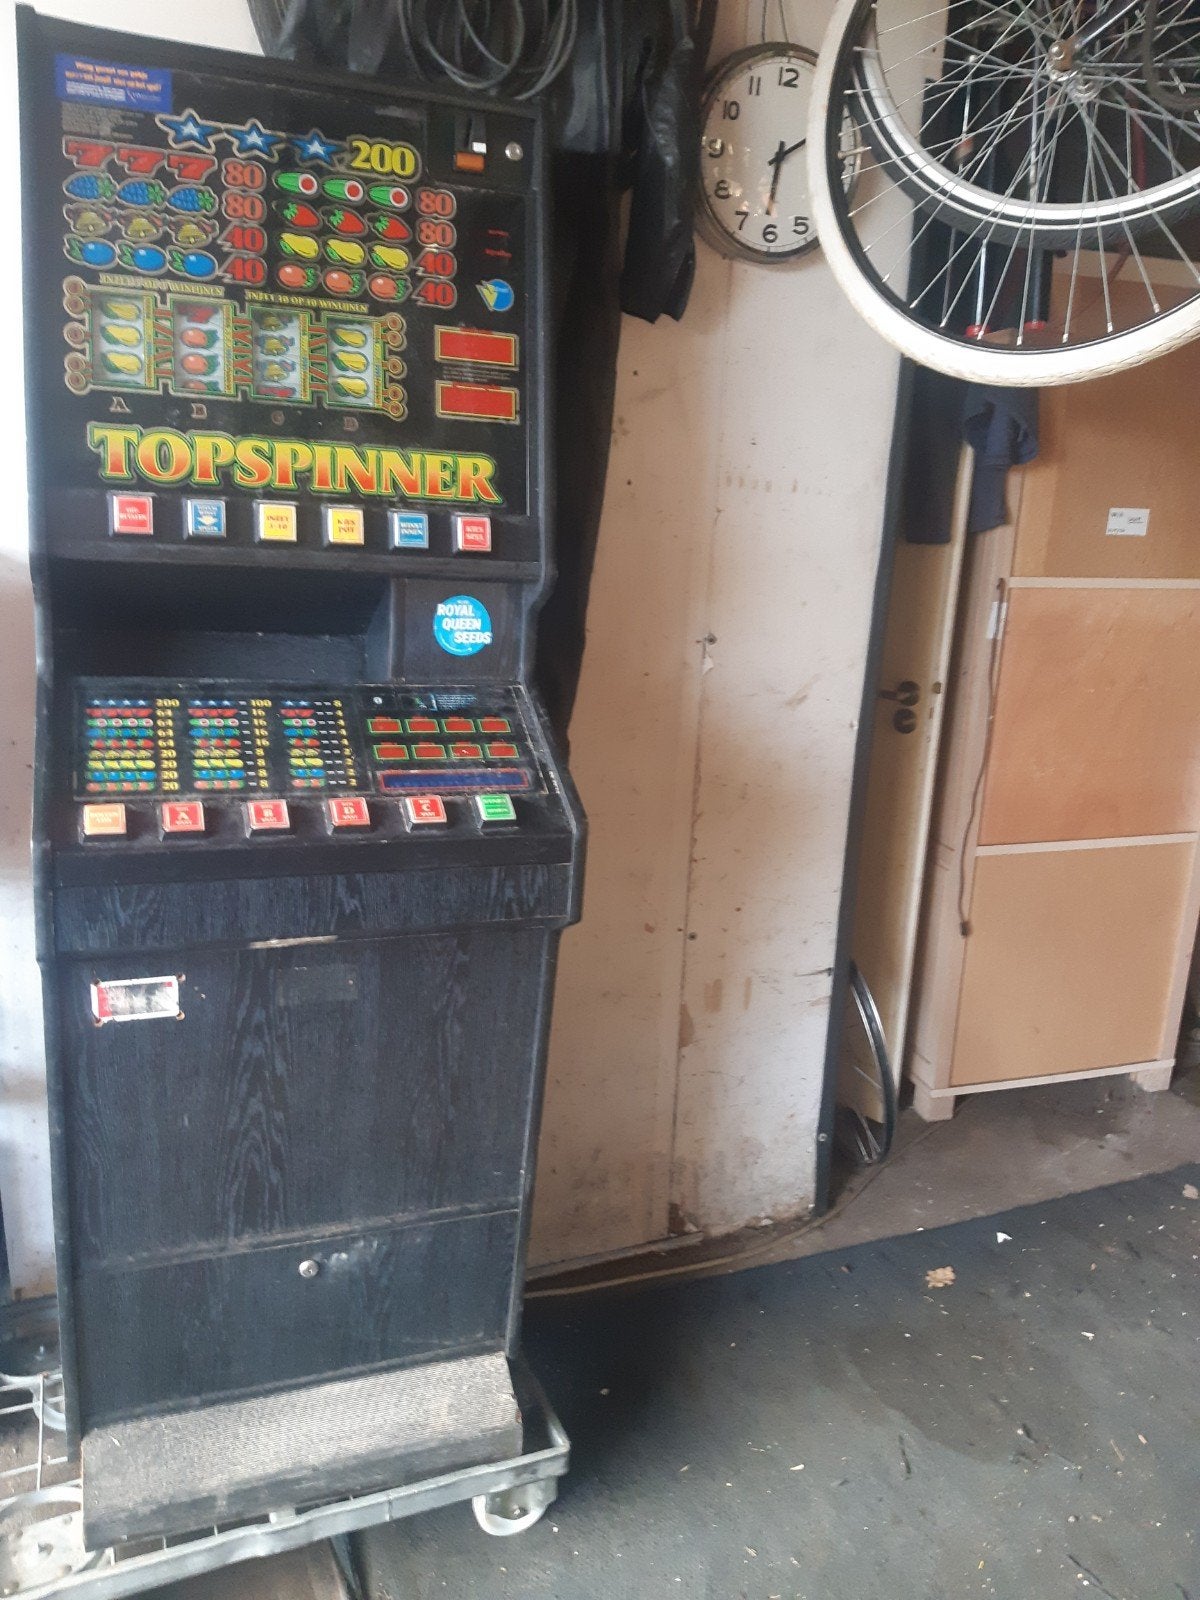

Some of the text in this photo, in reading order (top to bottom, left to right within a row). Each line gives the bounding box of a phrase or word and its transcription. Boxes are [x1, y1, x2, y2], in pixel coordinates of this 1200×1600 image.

[750, 76, 762, 96] 11
[778, 66, 800, 88] 12
[722, 100, 740, 120] 10
[350, 139, 416, 177] 200
[708, 139, 725, 159] 9
[223, 159, 265, 189] 80
[714, 179, 731, 200] 8
[223, 190, 265, 221] 80
[417, 189, 455, 217] 80
[735, 210, 749, 231] 7
[793, 215, 810, 235] 5
[224, 223, 265, 253] 40
[417, 219, 455, 248] 80
[762, 223, 778, 244] 6
[224, 254, 265, 284] 40
[417, 250, 455, 278] 40
[417, 281, 455, 308] 40
[109, 396, 132, 414] A
[89, 423, 501, 503] TOPSPINNER
[437, 603, 475, 617] ROYAL
[442, 617, 482, 631] QUEEN
[454, 631, 493, 645] SEEDS
[155, 698, 180, 708] 200
[250, 699, 272, 708] 100
[420, 803, 430, 812] C
